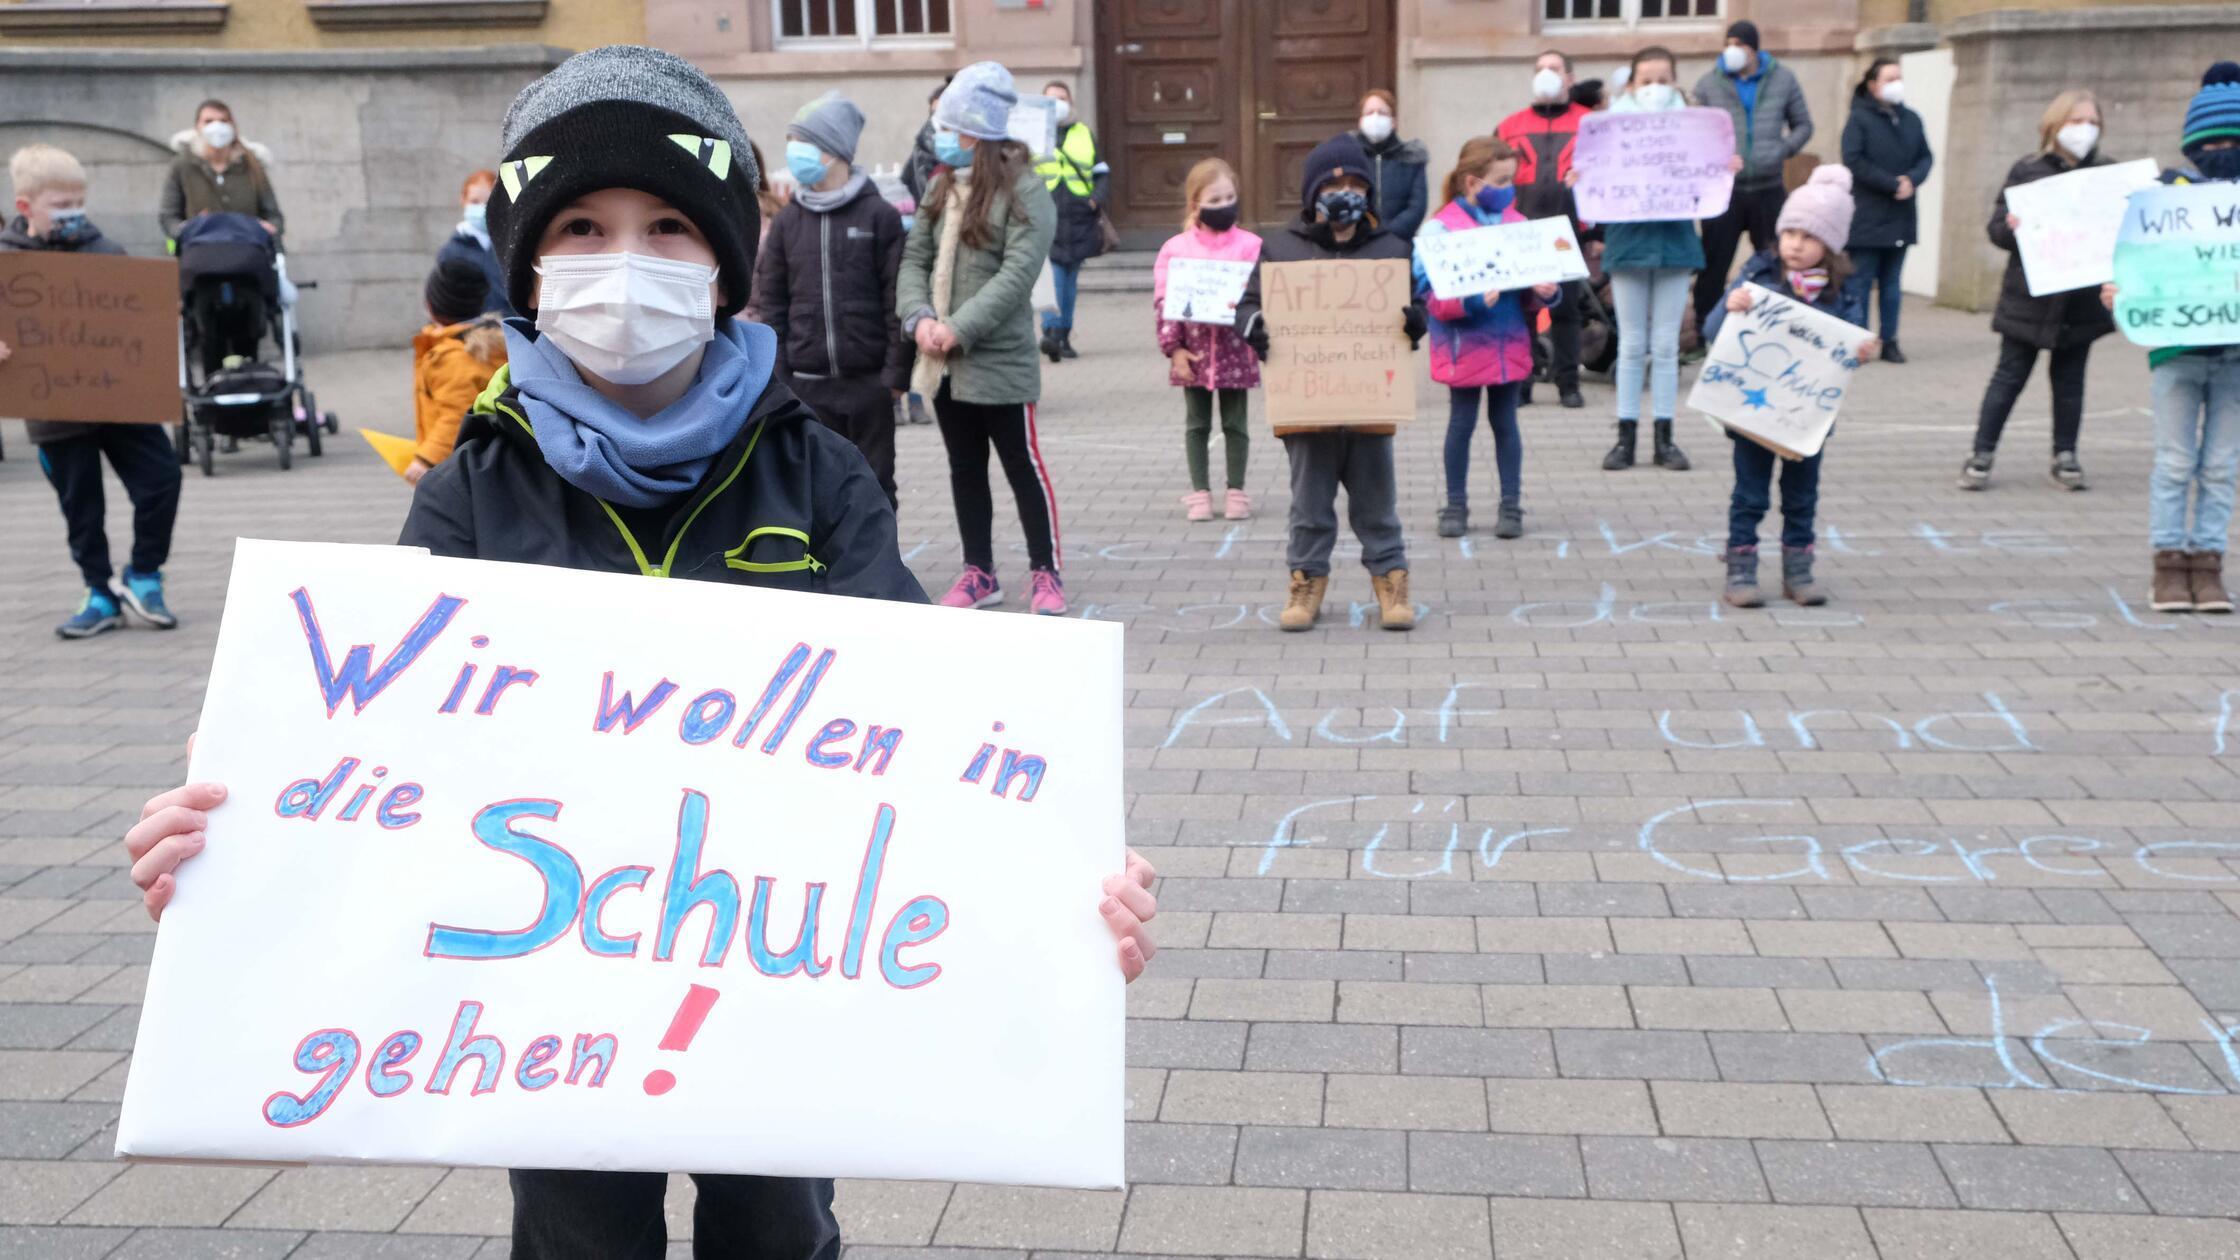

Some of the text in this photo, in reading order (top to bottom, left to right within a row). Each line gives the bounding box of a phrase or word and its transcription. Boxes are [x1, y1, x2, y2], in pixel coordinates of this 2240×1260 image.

[2139, 206, 2194, 234] WIR
[2127, 307, 2165, 328] DIE
[289, 588, 1046, 802] Wir wollen in
[1658, 690, 2044, 754] und
[274, 756, 950, 990] die Schule
